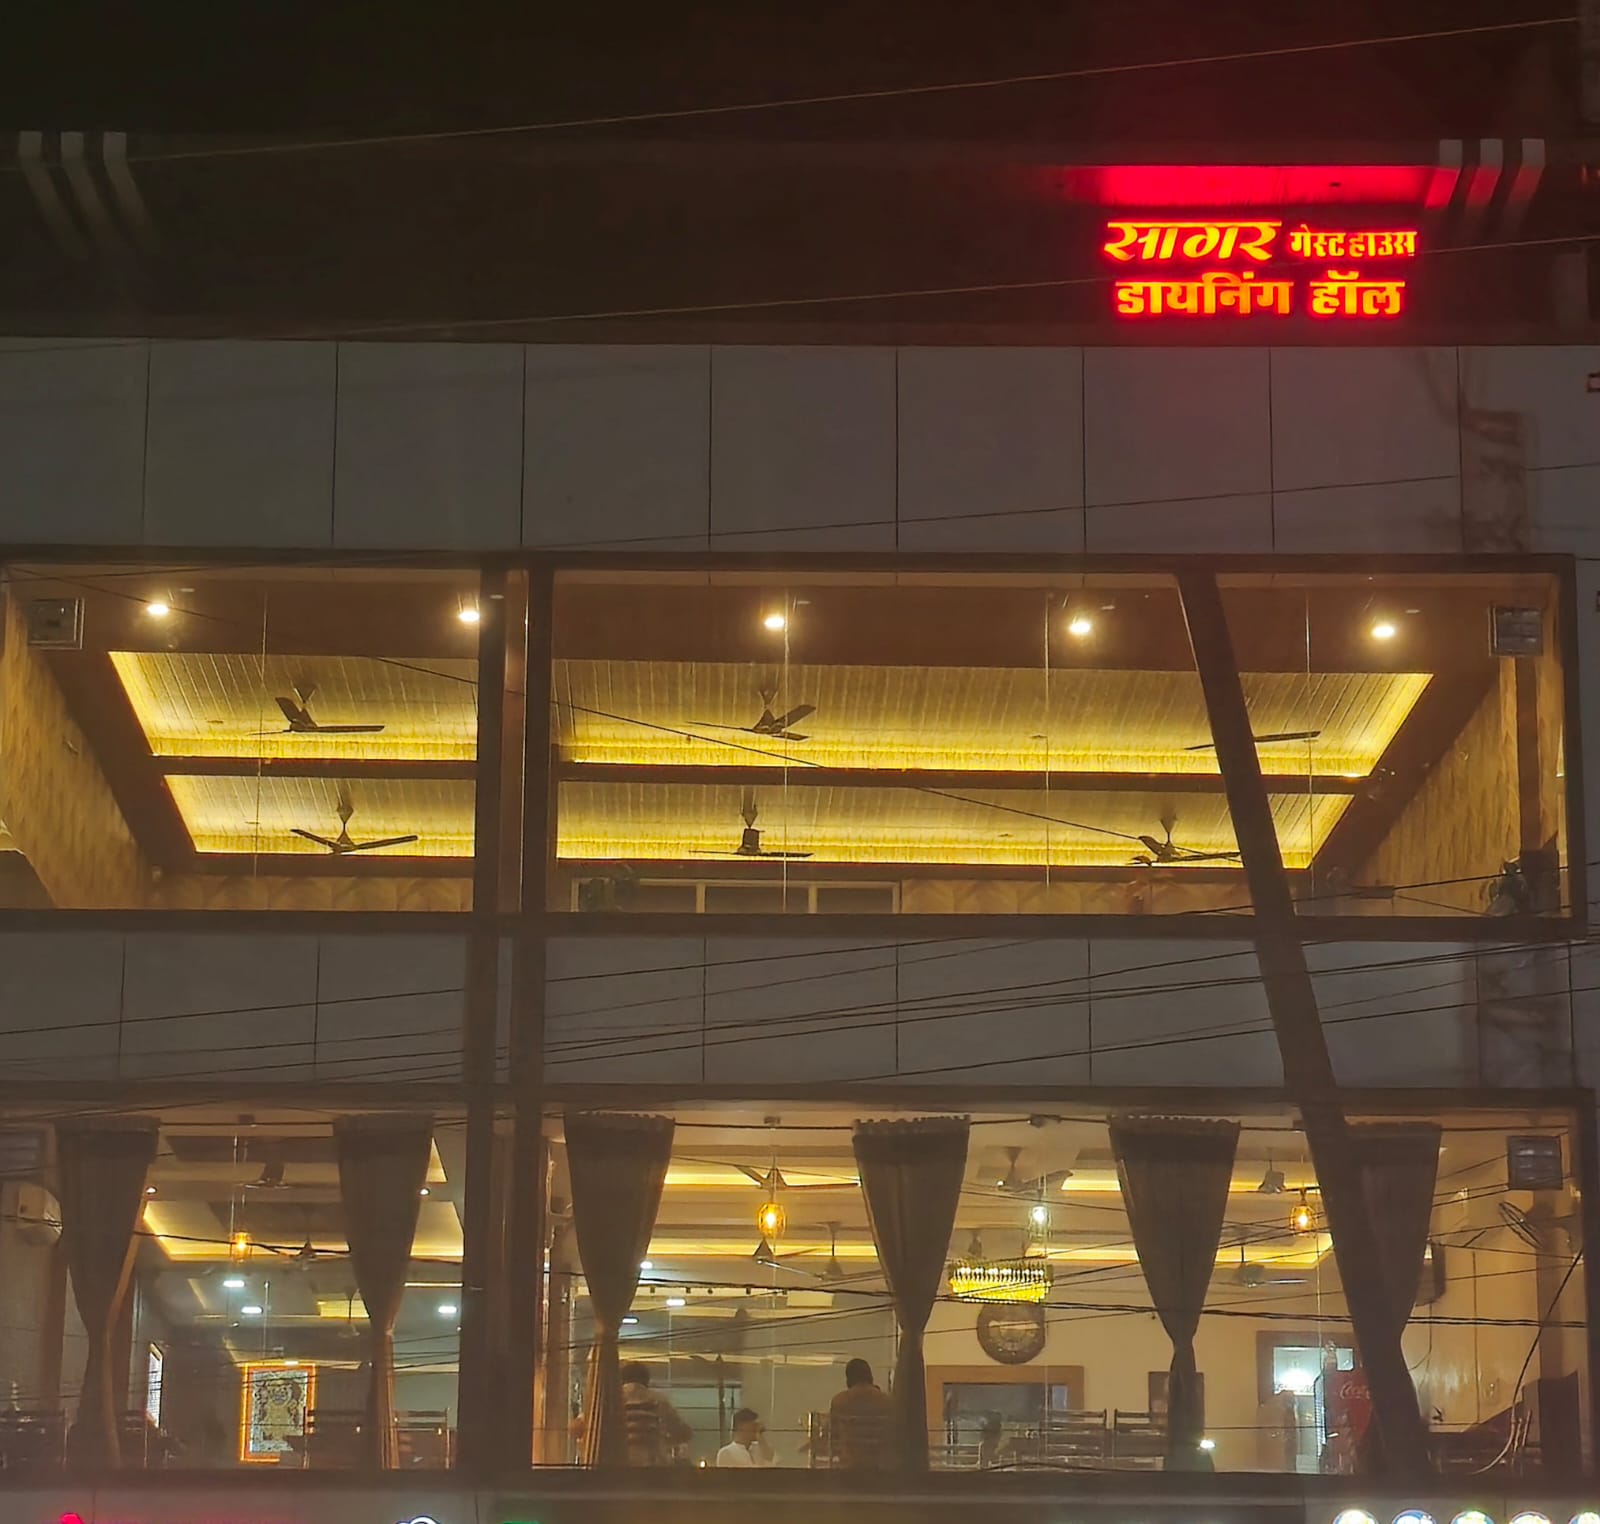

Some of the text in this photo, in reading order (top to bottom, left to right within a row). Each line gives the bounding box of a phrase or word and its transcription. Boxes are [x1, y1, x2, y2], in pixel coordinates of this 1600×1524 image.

[1104, 221, 1418, 261] सागर गेस्ट हाउस
[1115, 270, 1406, 315] डायनिंग हॉल
